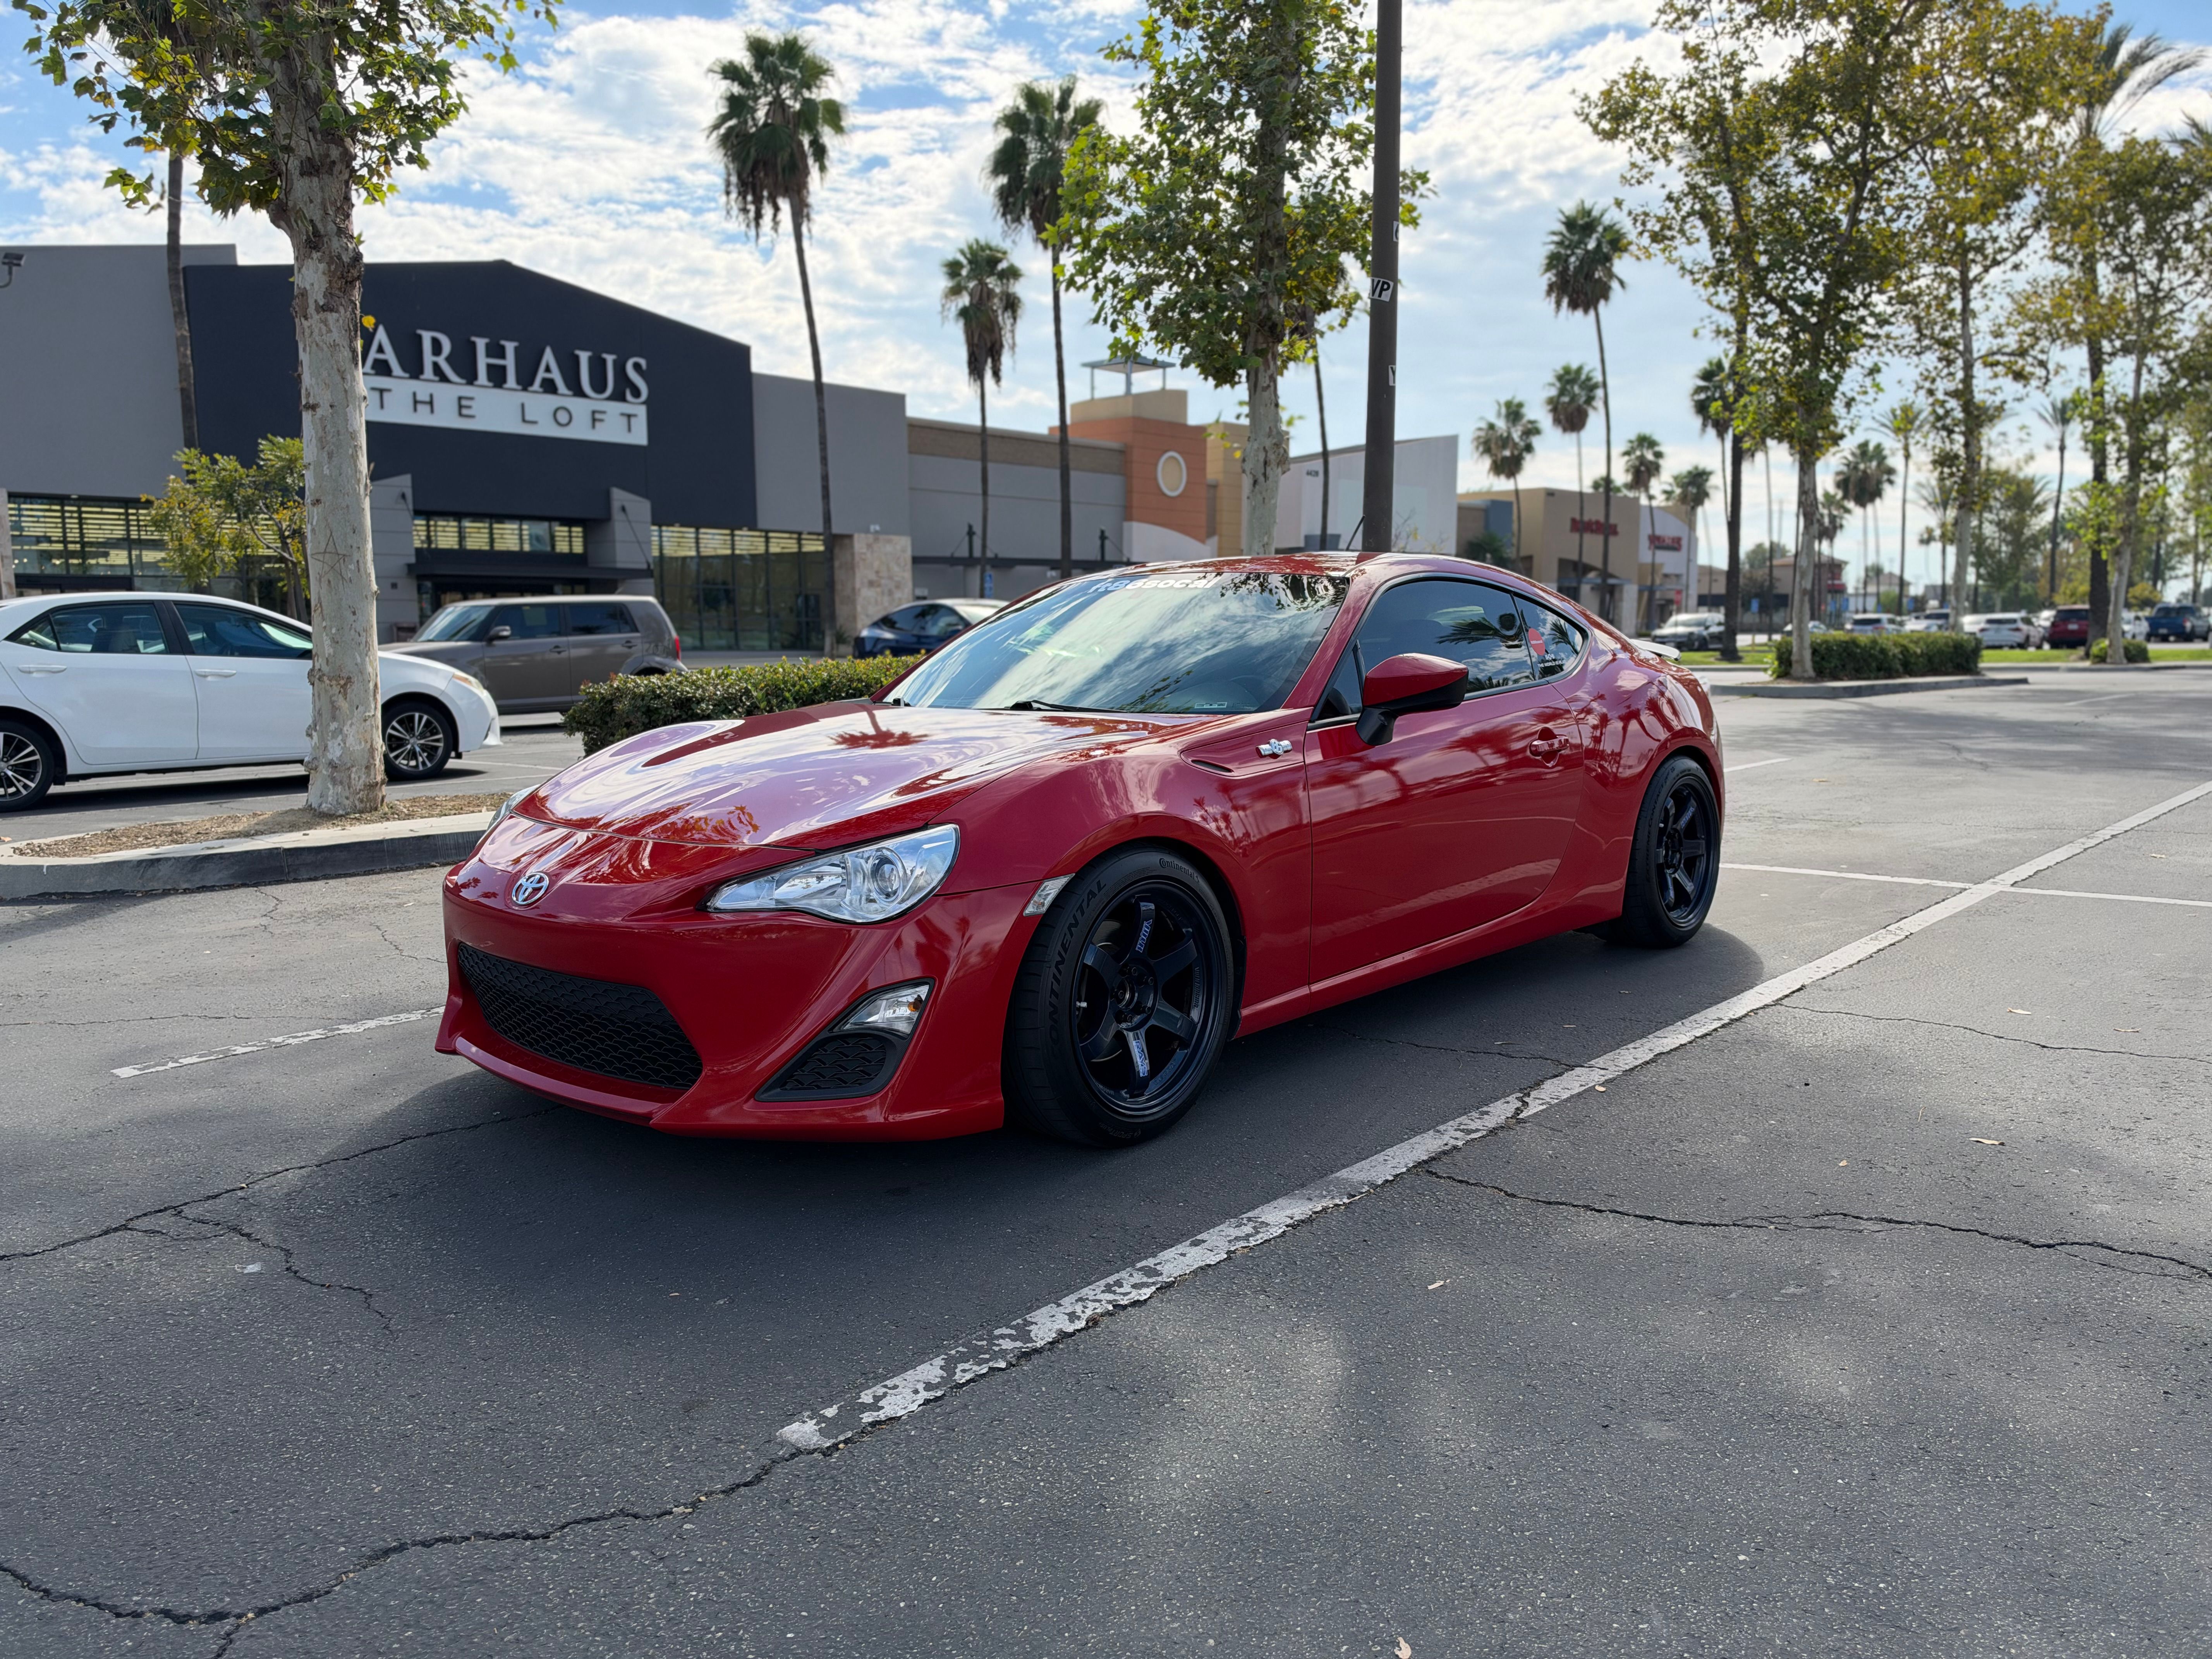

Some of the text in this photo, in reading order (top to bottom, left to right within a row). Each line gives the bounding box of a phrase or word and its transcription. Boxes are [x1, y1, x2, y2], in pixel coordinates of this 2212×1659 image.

[363, 324, 648, 404] ARHAUS
[371, 388, 638, 433] THE LOFT
[1087, 577, 1221, 593] ft86socal
[1159, 858, 1195, 880] Continental
[1048, 880, 1106, 1046] ONTINENTAL
[1135, 1040, 1147, 1076] RAYS
